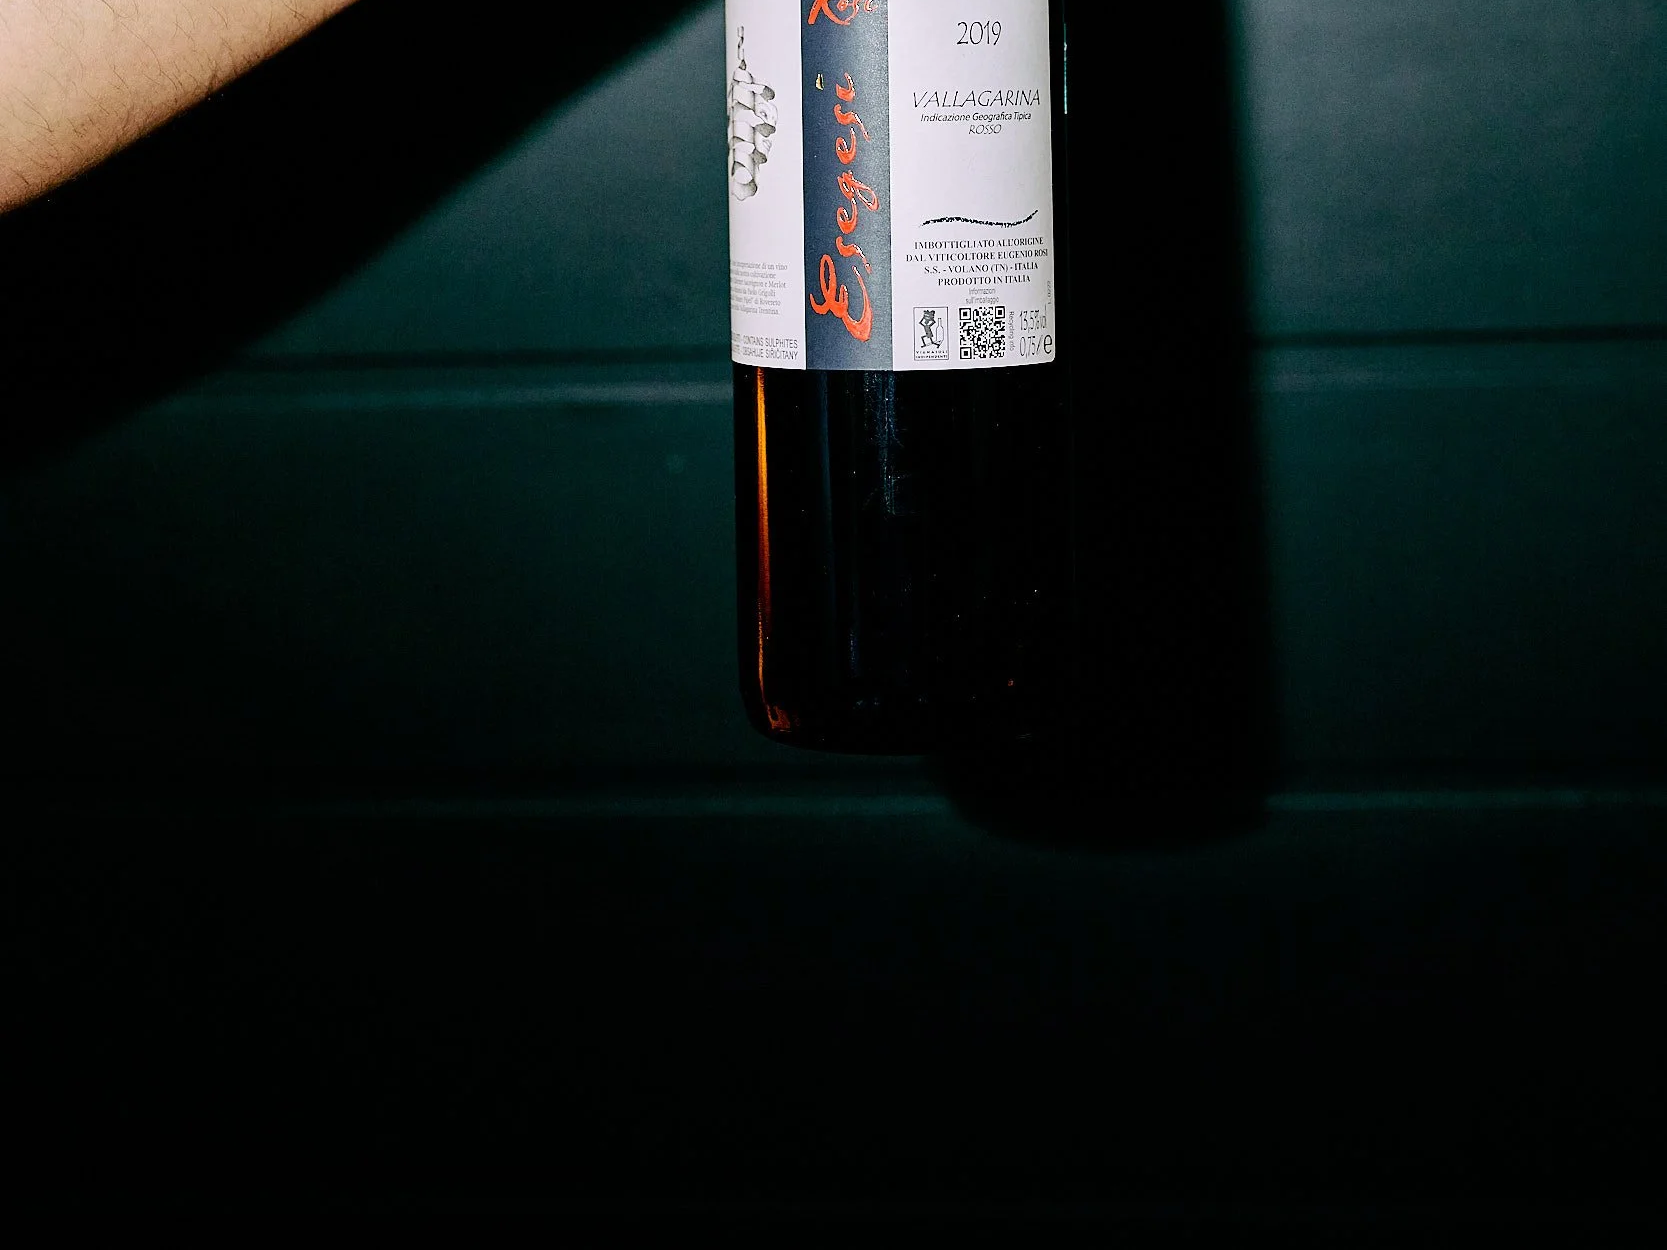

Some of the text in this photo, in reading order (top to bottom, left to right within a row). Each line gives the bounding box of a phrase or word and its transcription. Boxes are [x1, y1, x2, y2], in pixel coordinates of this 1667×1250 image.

[956, 20, 1002, 46] 2019
[912, 88, 1041, 108] VALLAGARINA
[920, 111, 1032, 123] Indicazione Geografica Tipica
[968, 123, 1002, 135] ROSSO
[809, 72, 879, 342] Esegesi
[914, 239, 995, 250] IMBOTTIGLIATO
[906, 248, 1049, 262] DAL VITICOLTORE EUGENIO ROSI
[924, 265, 941, 274] S.S.
[948, 263, 989, 274] VOLANO
[990, 263, 1009, 273] (TN)
[1014, 261, 1039, 271] ITALIA
[938, 274, 1031, 286] PRODOTTO IN ITALIA
[765, 336, 798, 349] SULPHITES
